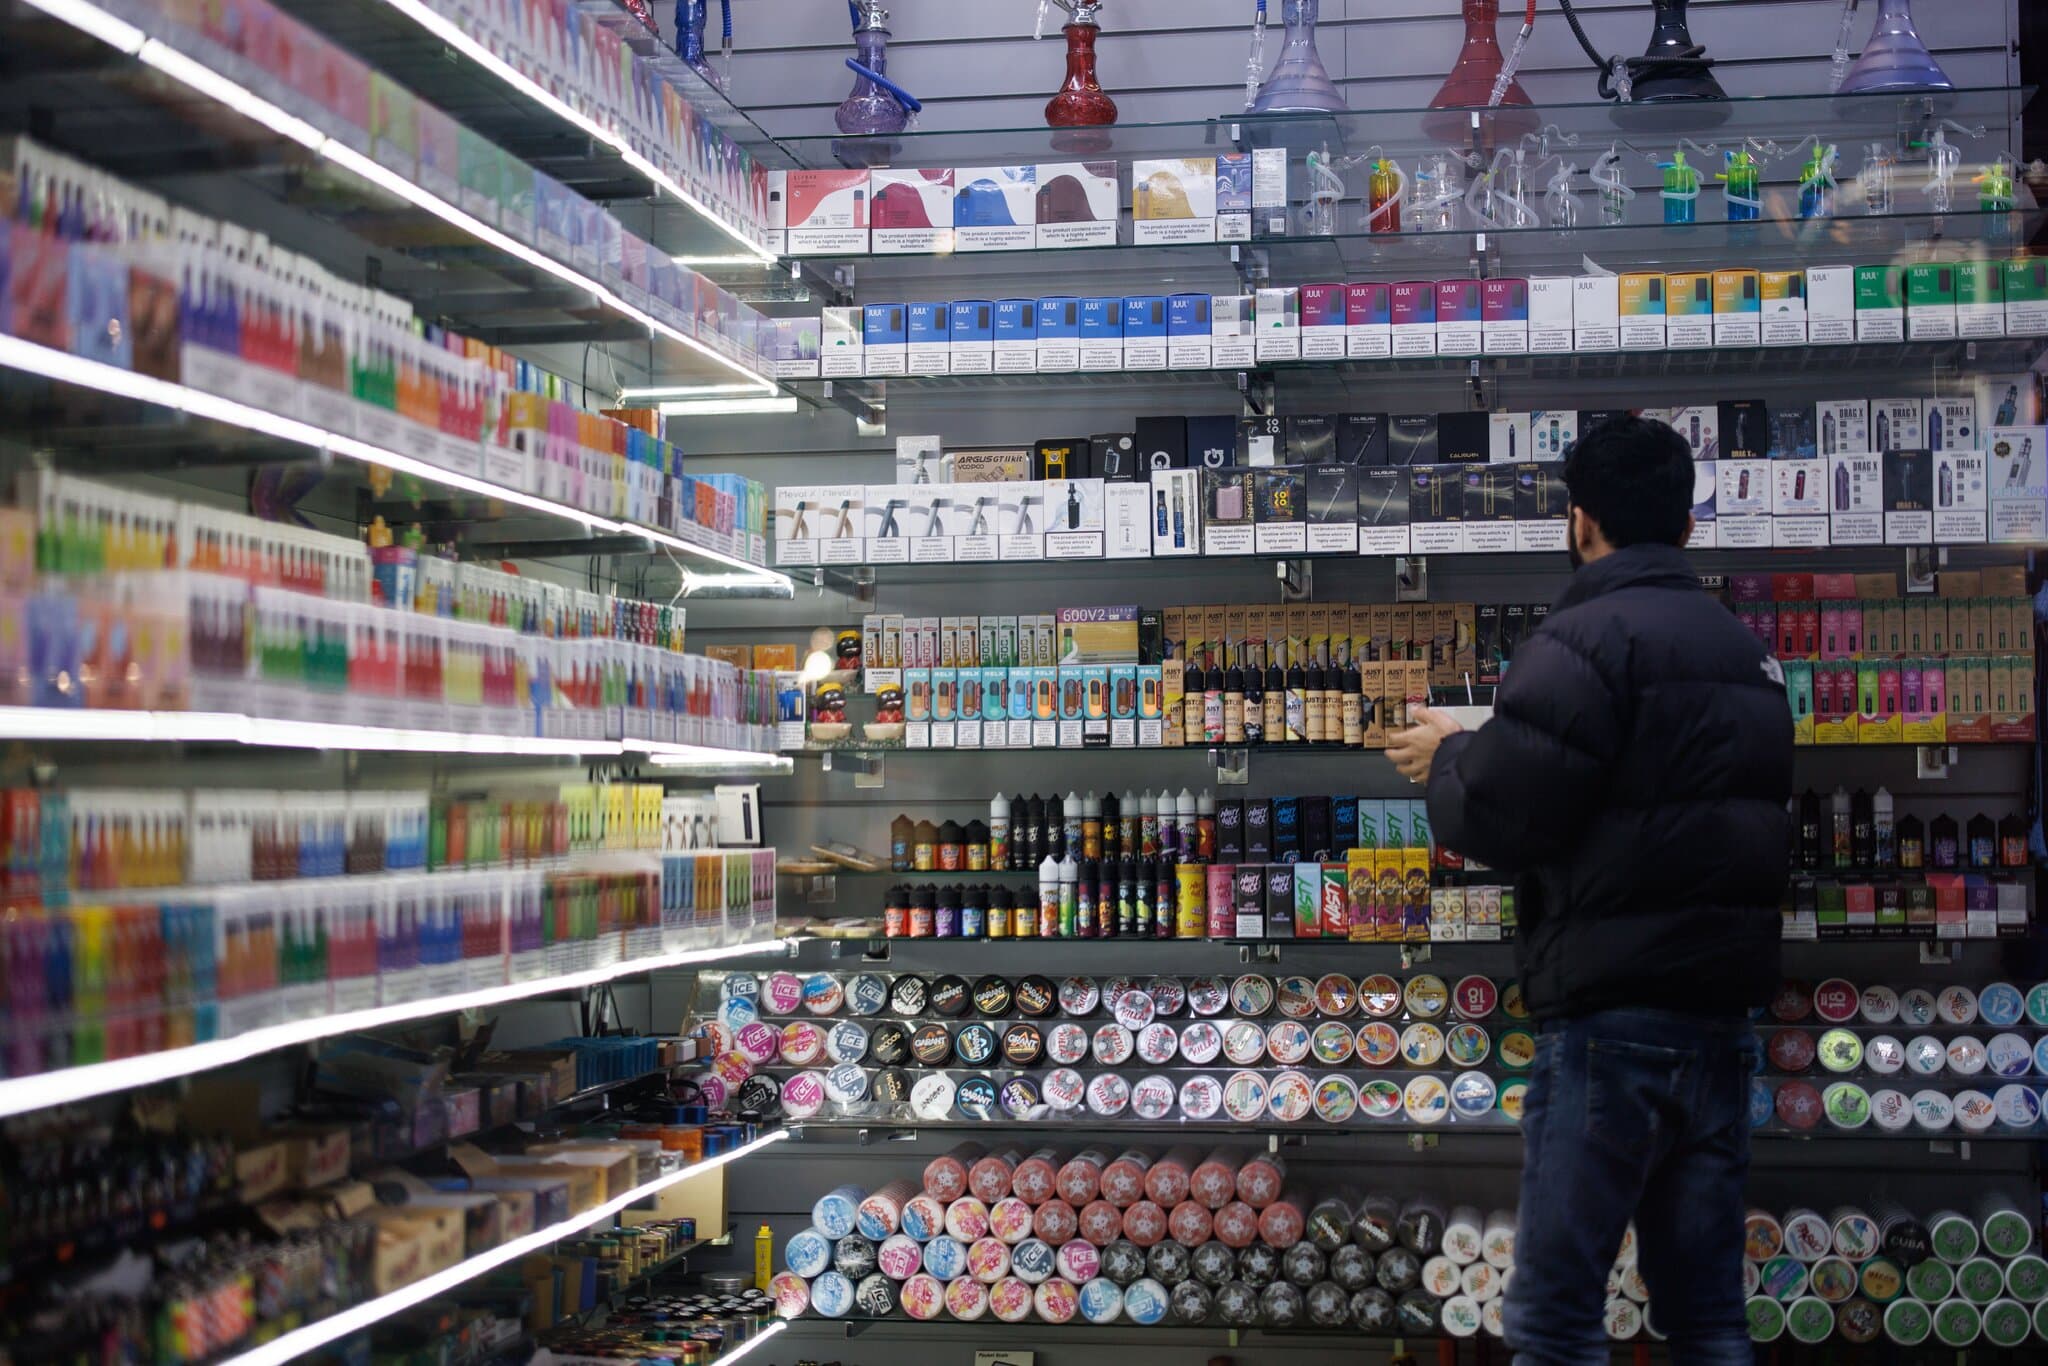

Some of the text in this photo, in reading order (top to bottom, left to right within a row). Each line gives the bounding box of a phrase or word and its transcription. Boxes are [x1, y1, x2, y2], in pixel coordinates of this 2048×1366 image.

[1063, 609, 1105, 622] 600V2
[734, 983, 753, 993] ICE
[778, 986, 796, 995] ICE
[862, 986, 880, 1000] ICE
[933, 985, 963, 1000] GARANT
[976, 986, 1006, 1001] GARANT
[750, 1029, 767, 1044] ICE
[842, 1036, 861, 1046] ICE
[840, 1070, 857, 1085] ICE
[794, 1078, 811, 1098] ICE
[961, 1089, 992, 1104] GARANT
[1026, 1247, 1041, 1262] ICE
[1073, 1252, 1092, 1262] ICE
[876, 1290, 889, 1309] ICE
